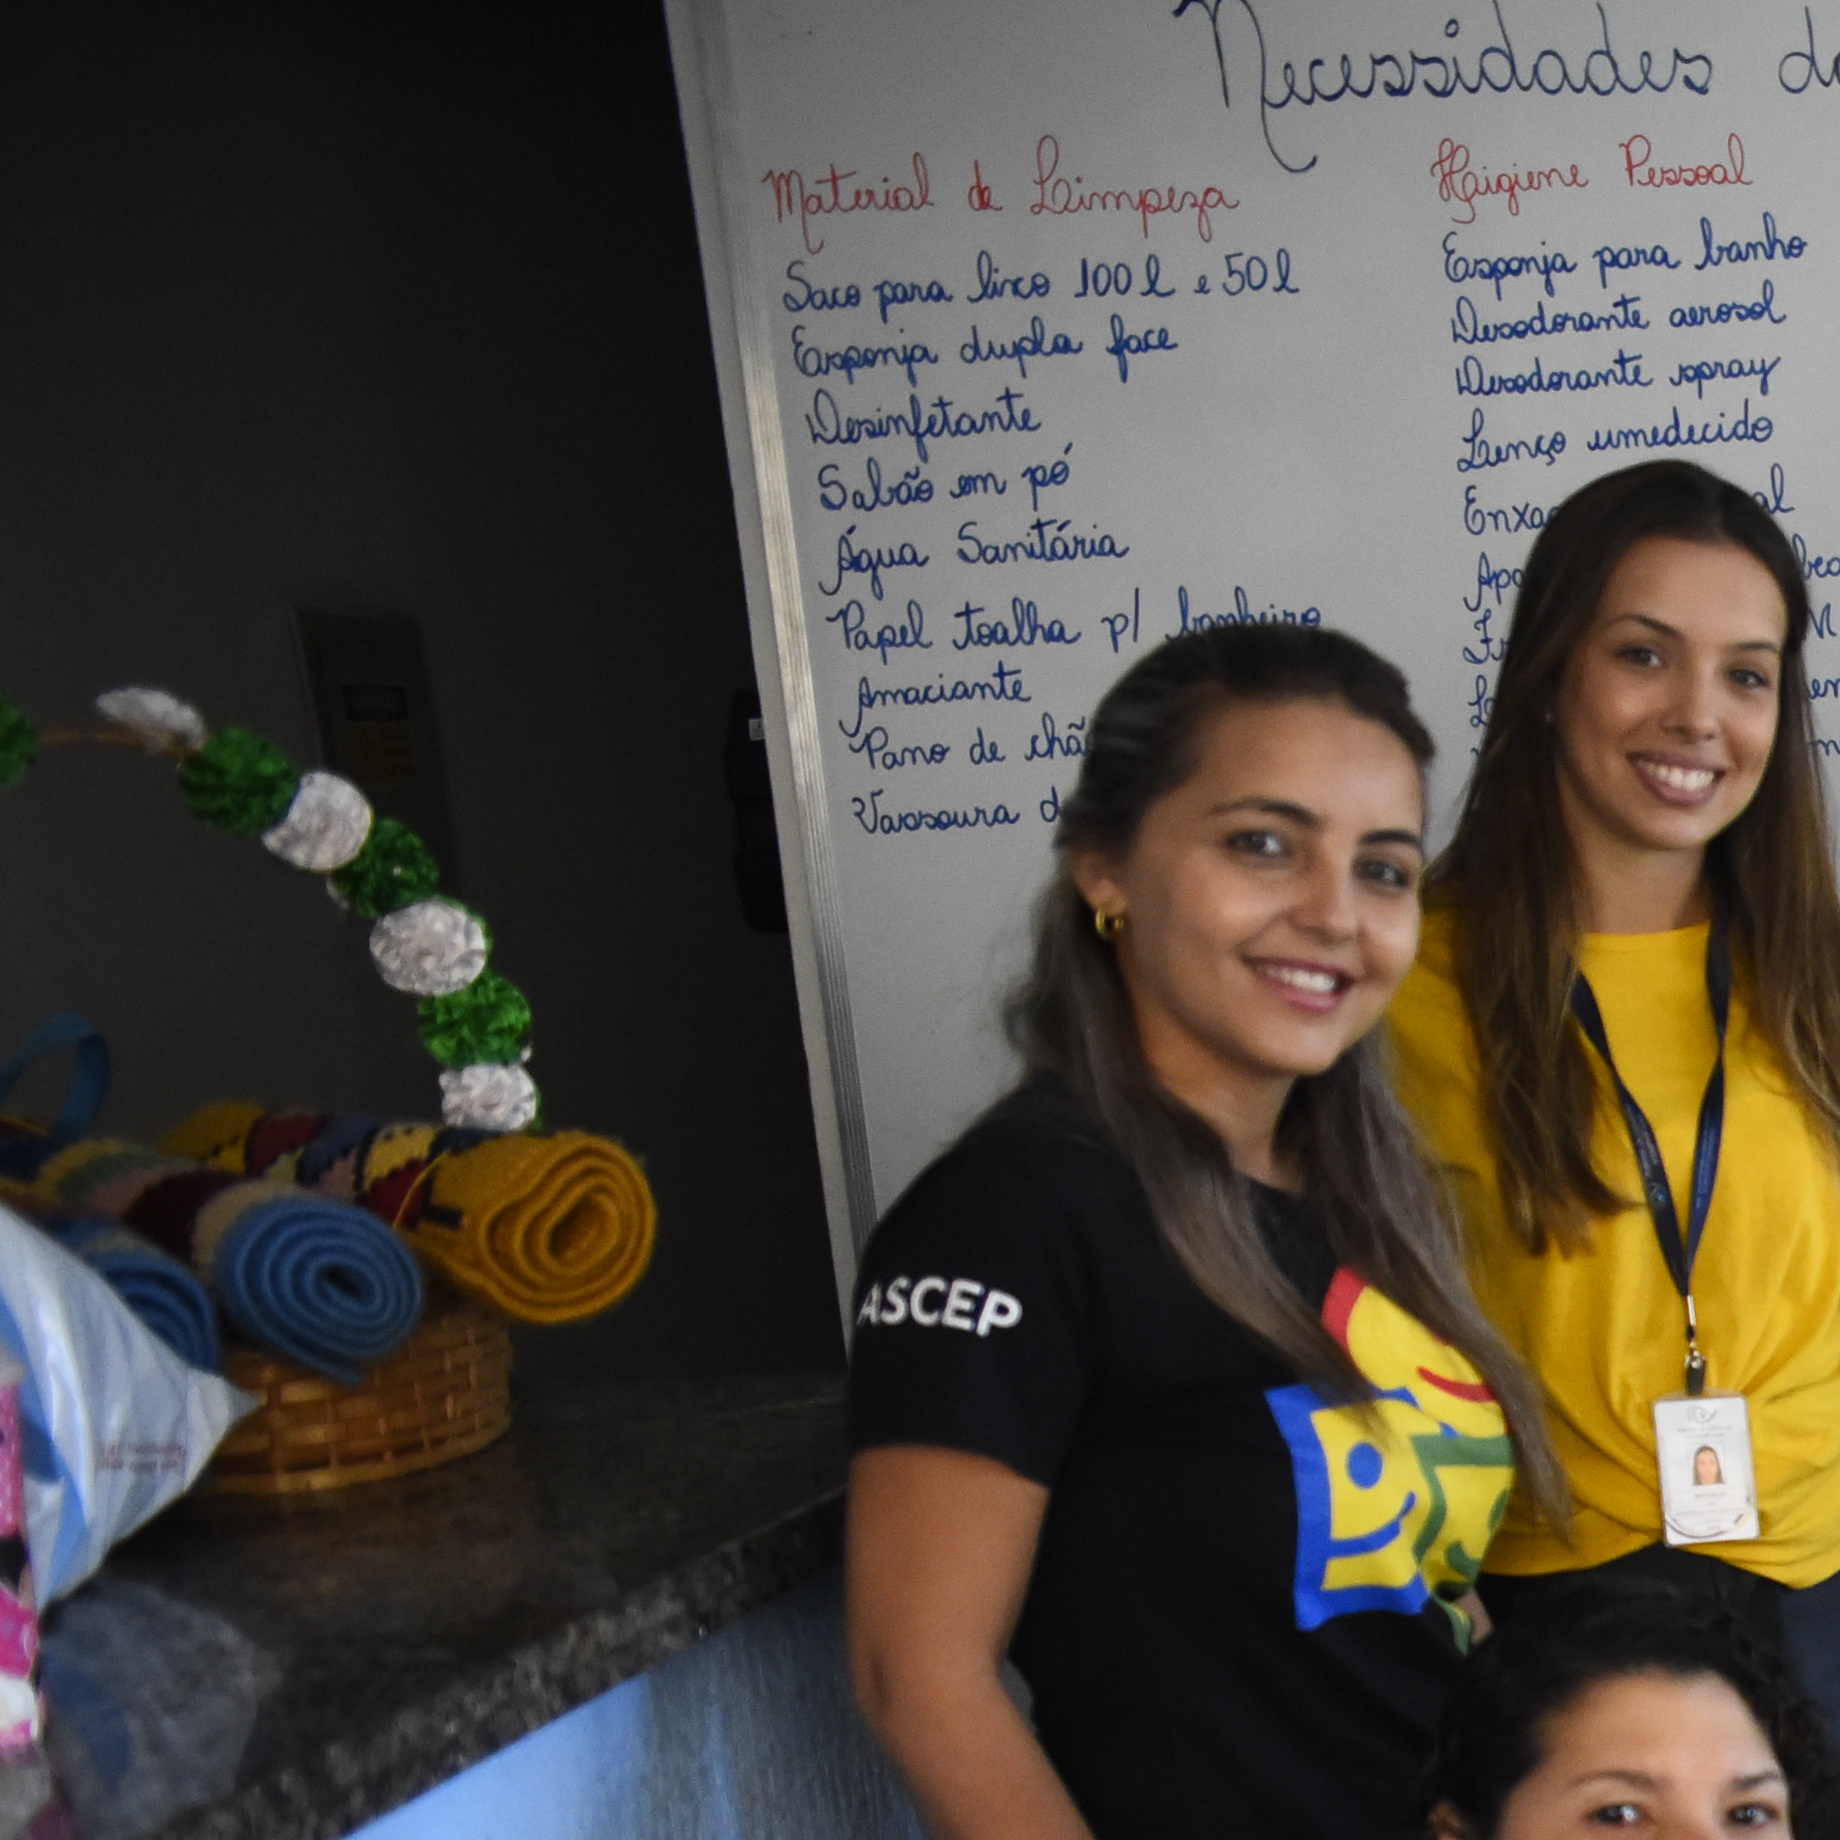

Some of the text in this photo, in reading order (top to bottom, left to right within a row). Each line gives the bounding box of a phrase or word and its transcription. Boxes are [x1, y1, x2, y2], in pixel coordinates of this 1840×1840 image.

[763, 135, 1239, 255] Material de Limpeza
[1619, 133, 1754, 187] Pessoal
[783, 260, 861, 312] Saco
[872, 278, 953, 323] para
[967, 250, 1052, 304] lixo
[1442, 210, 1809, 301] Esponja para banho
[1451, 278, 1787, 344] Desodorante aerosol
[793, 313, 1179, 385] Esponja dupla face
[1456, 347, 1782, 399] Desodorante spray
[804, 386, 1042, 461] Desinfetante
[1456, 396, 1774, 473] Lenço umedecido
[818, 442, 1074, 512] Sabão em pó
[818, 518, 1130, 600] Água Sanitária
[825, 599, 933, 665] Papel
[951, 600, 1082, 651] toalha
[839, 660, 1033, 737] Amaciante
[850, 727, 951, 771] Pano
[968, 725, 1006, 765] de
[852, 790, 1021, 836] Vassoura
[857, 1275, 1023, 1339] ASCEP
